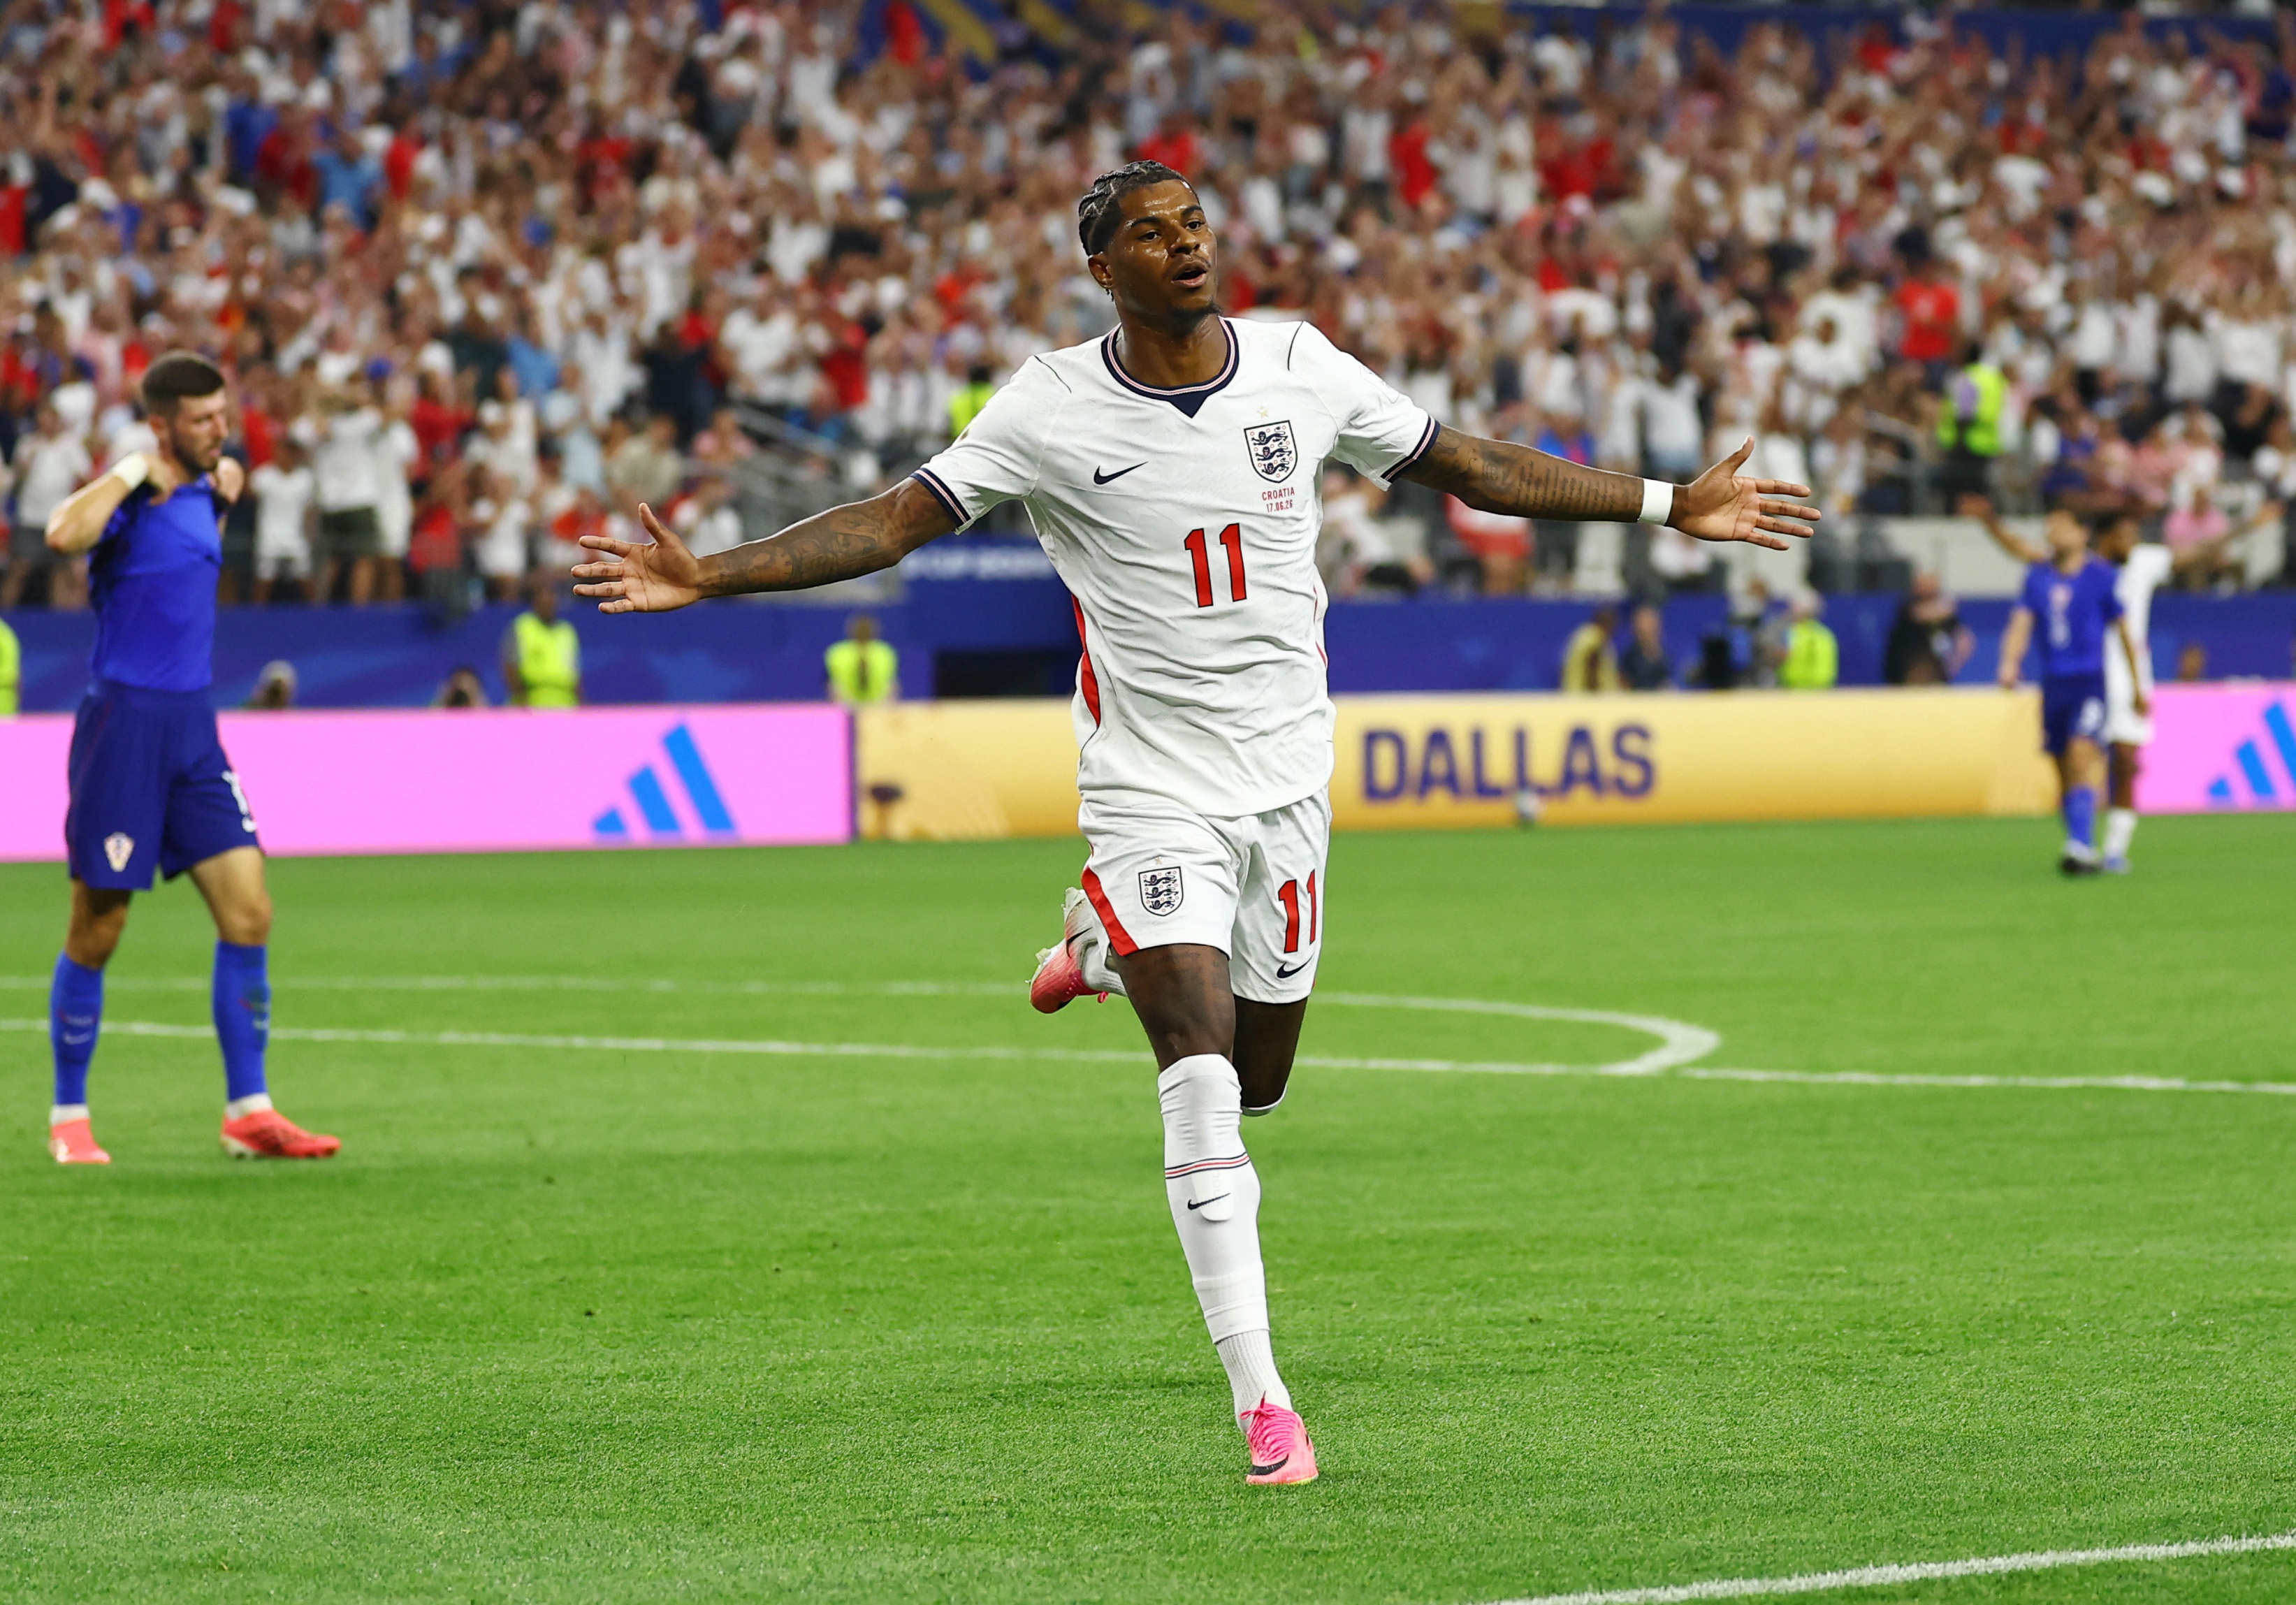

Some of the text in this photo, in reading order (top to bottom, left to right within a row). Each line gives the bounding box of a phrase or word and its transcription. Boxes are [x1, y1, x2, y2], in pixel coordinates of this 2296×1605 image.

[1261, 486, 1295, 501] CROATIA
[1265, 499, 1293, 513] 17.06.26
[1184, 522, 1247, 609] 11
[1363, 725, 1655, 801] DALLAS
[1277, 869, 1317, 954] 11
